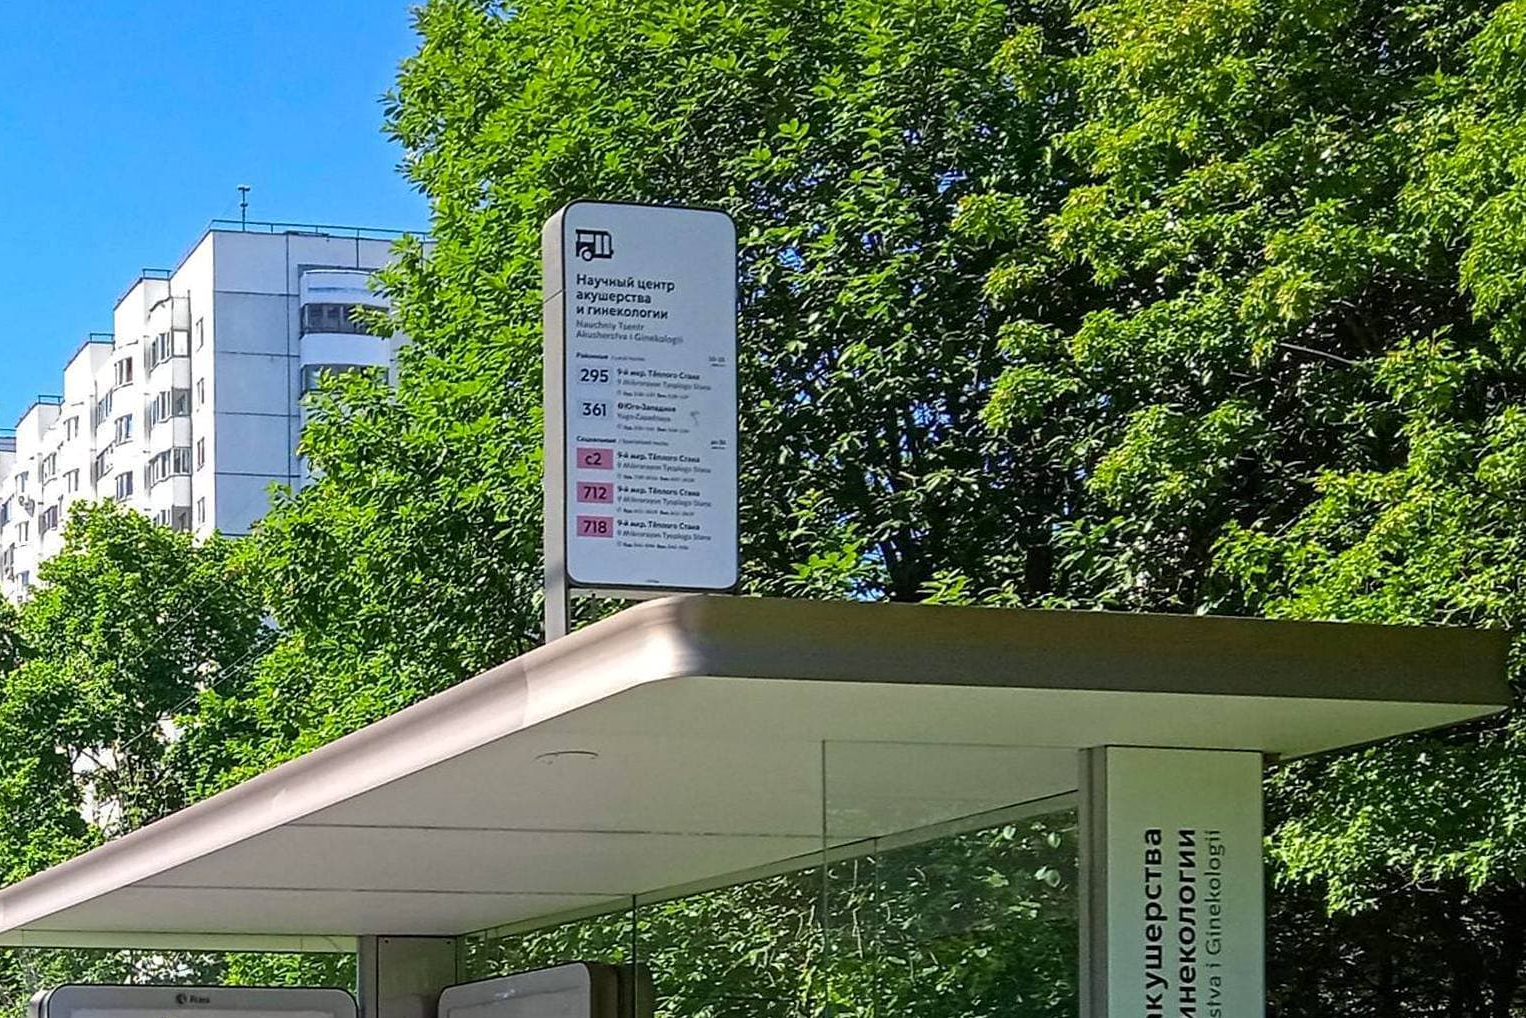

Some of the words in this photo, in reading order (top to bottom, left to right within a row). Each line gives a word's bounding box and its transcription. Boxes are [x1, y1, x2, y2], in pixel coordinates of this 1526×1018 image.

[576, 273, 635, 289] Научный
[637, 280, 675, 293] центр
[576, 290, 652, 304] акушерства
[576, 306, 584, 315] и
[587, 306, 669, 319] гинекологии
[580, 368, 609, 383] 295
[582, 402, 607, 417] 361
[583, 486, 607, 500] 712
[583, 520, 607, 534] 718
[1204, 829, 1225, 956] Ginekologii
